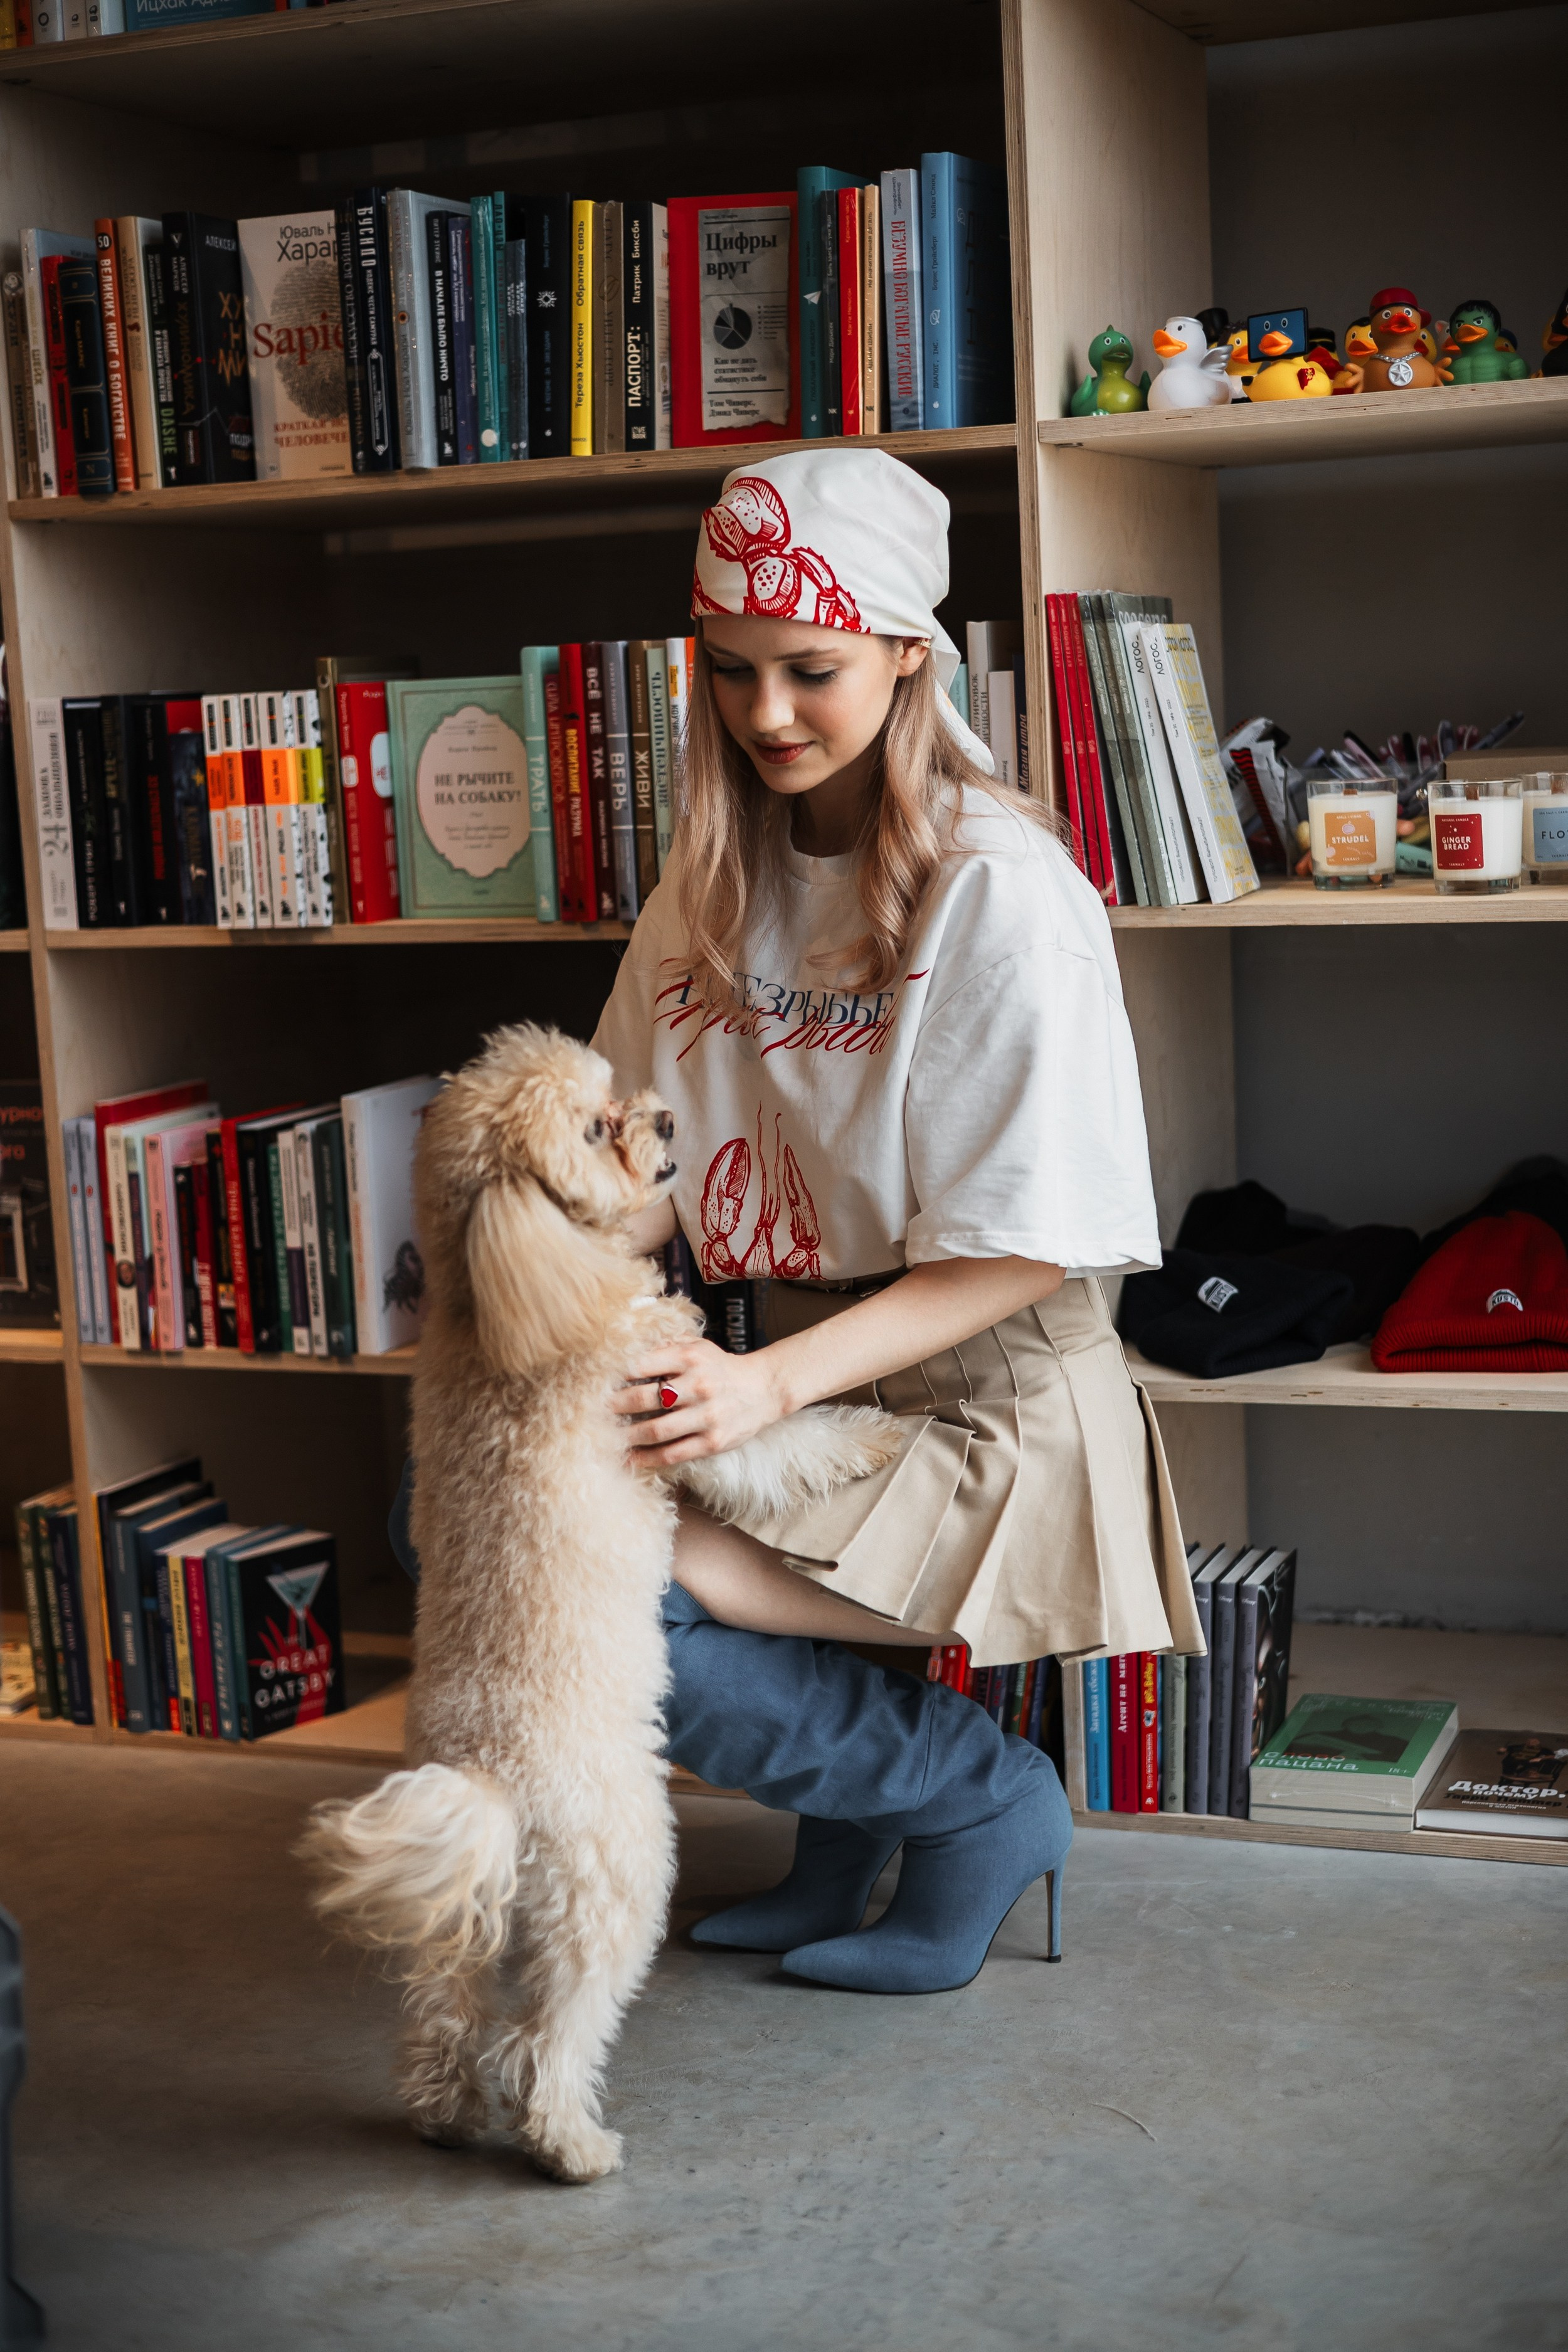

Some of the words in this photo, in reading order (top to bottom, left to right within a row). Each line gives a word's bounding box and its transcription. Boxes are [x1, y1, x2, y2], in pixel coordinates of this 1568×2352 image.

[98, 235, 110, 247] 50
[280, 225, 325, 240] Юваль
[356, 206, 378, 267] БУСИДО
[432, 218, 440, 238] ПИТЕР
[576, 221, 585, 251] связь
[603, 218, 613, 263] СТАТУС
[630, 220, 641, 258] Биксби
[706, 232, 777, 253] Цифры
[277, 239, 339, 266] Хара
[341, 231, 354, 278] ВОЙНЫ
[891, 220, 908, 279] БЕЗУМНО
[930, 235, 940, 269] Гройсберг
[180, 257, 189, 294] АЛЕКСЕЙ
[365, 269, 374, 294] КОДЕКС
[575, 254, 586, 306] Обратная
[631, 265, 642, 304] Патрик
[706, 260, 751, 280] врут
[100, 259, 114, 317] ВЕЛИКИХ
[435, 278, 445, 315] НАЧАЛЕ
[343, 283, 358, 359] ИСКУССТВО
[367, 295, 376, 315] ЧЕСТИ
[893, 282, 910, 341] БОГАТЫЕ
[105, 323, 117, 354] КНИГ
[253, 310, 344, 365] Sapie
[369, 316, 378, 346] САМУРАЯ
[437, 319, 447, 347] БЫЛО
[575, 322, 585, 369] Хьюстон
[177, 302, 194, 415] ХУЛИНОМИКА
[438, 349, 449, 381] НИЧТО
[603, 347, 615, 386] СТОРР
[627, 326, 642, 408] ПАСПОРТ:
[897, 343, 913, 398] РУССКИЕ
[933, 360, 941, 389] ДИАЛОГ,
[575, 371, 584, 408] Тереза
[110, 374, 125, 440] БОГАТСТВЕ
[160, 408, 177, 455] DASHE
[275, 432, 349, 448] ЧЕЛОВЕЧЕ
[586, 667, 601, 700] ВСЁ
[589, 712, 603, 735] НЕ
[1019, 714, 1028, 746] утра
[565, 728, 581, 793] ВОСПИТАНИЕ
[591, 747, 605, 779] ТАК
[1019, 748, 1029, 791] Магия
[434, 773, 453, 787] НЕ
[457, 770, 515, 787] РЫЧИТЕ
[529, 754, 546, 813] ТРАТЬ
[609, 752, 627, 811] ВЕРЬ
[633, 751, 650, 809] ЖИВИ
[434, 792, 455, 805] НА
[458, 790, 522, 805] СОБАКУ!
[571, 797, 582, 837] РАЗУМА
[41, 824, 69, 857] 24
[1332, 834, 1369, 844] STRUDEL
[1542, 830, 1568, 839] FLO
[259, 1643, 327, 1681] GREAT
[1088, 1660, 1098, 1692] сбежа
[255, 1668, 336, 1709] GATSBY
[1119, 1684, 1126, 1697] на
[1089, 1695, 1099, 1732] Загадка
[1118, 1700, 1127, 1732] Агент
[1258, 1757, 1359, 1771] пацана
[1448, 1781, 1566, 1799] Доктор,
[1472, 1789, 1538, 1799] почему
[1495, 1795, 1562, 1806] Поттер
